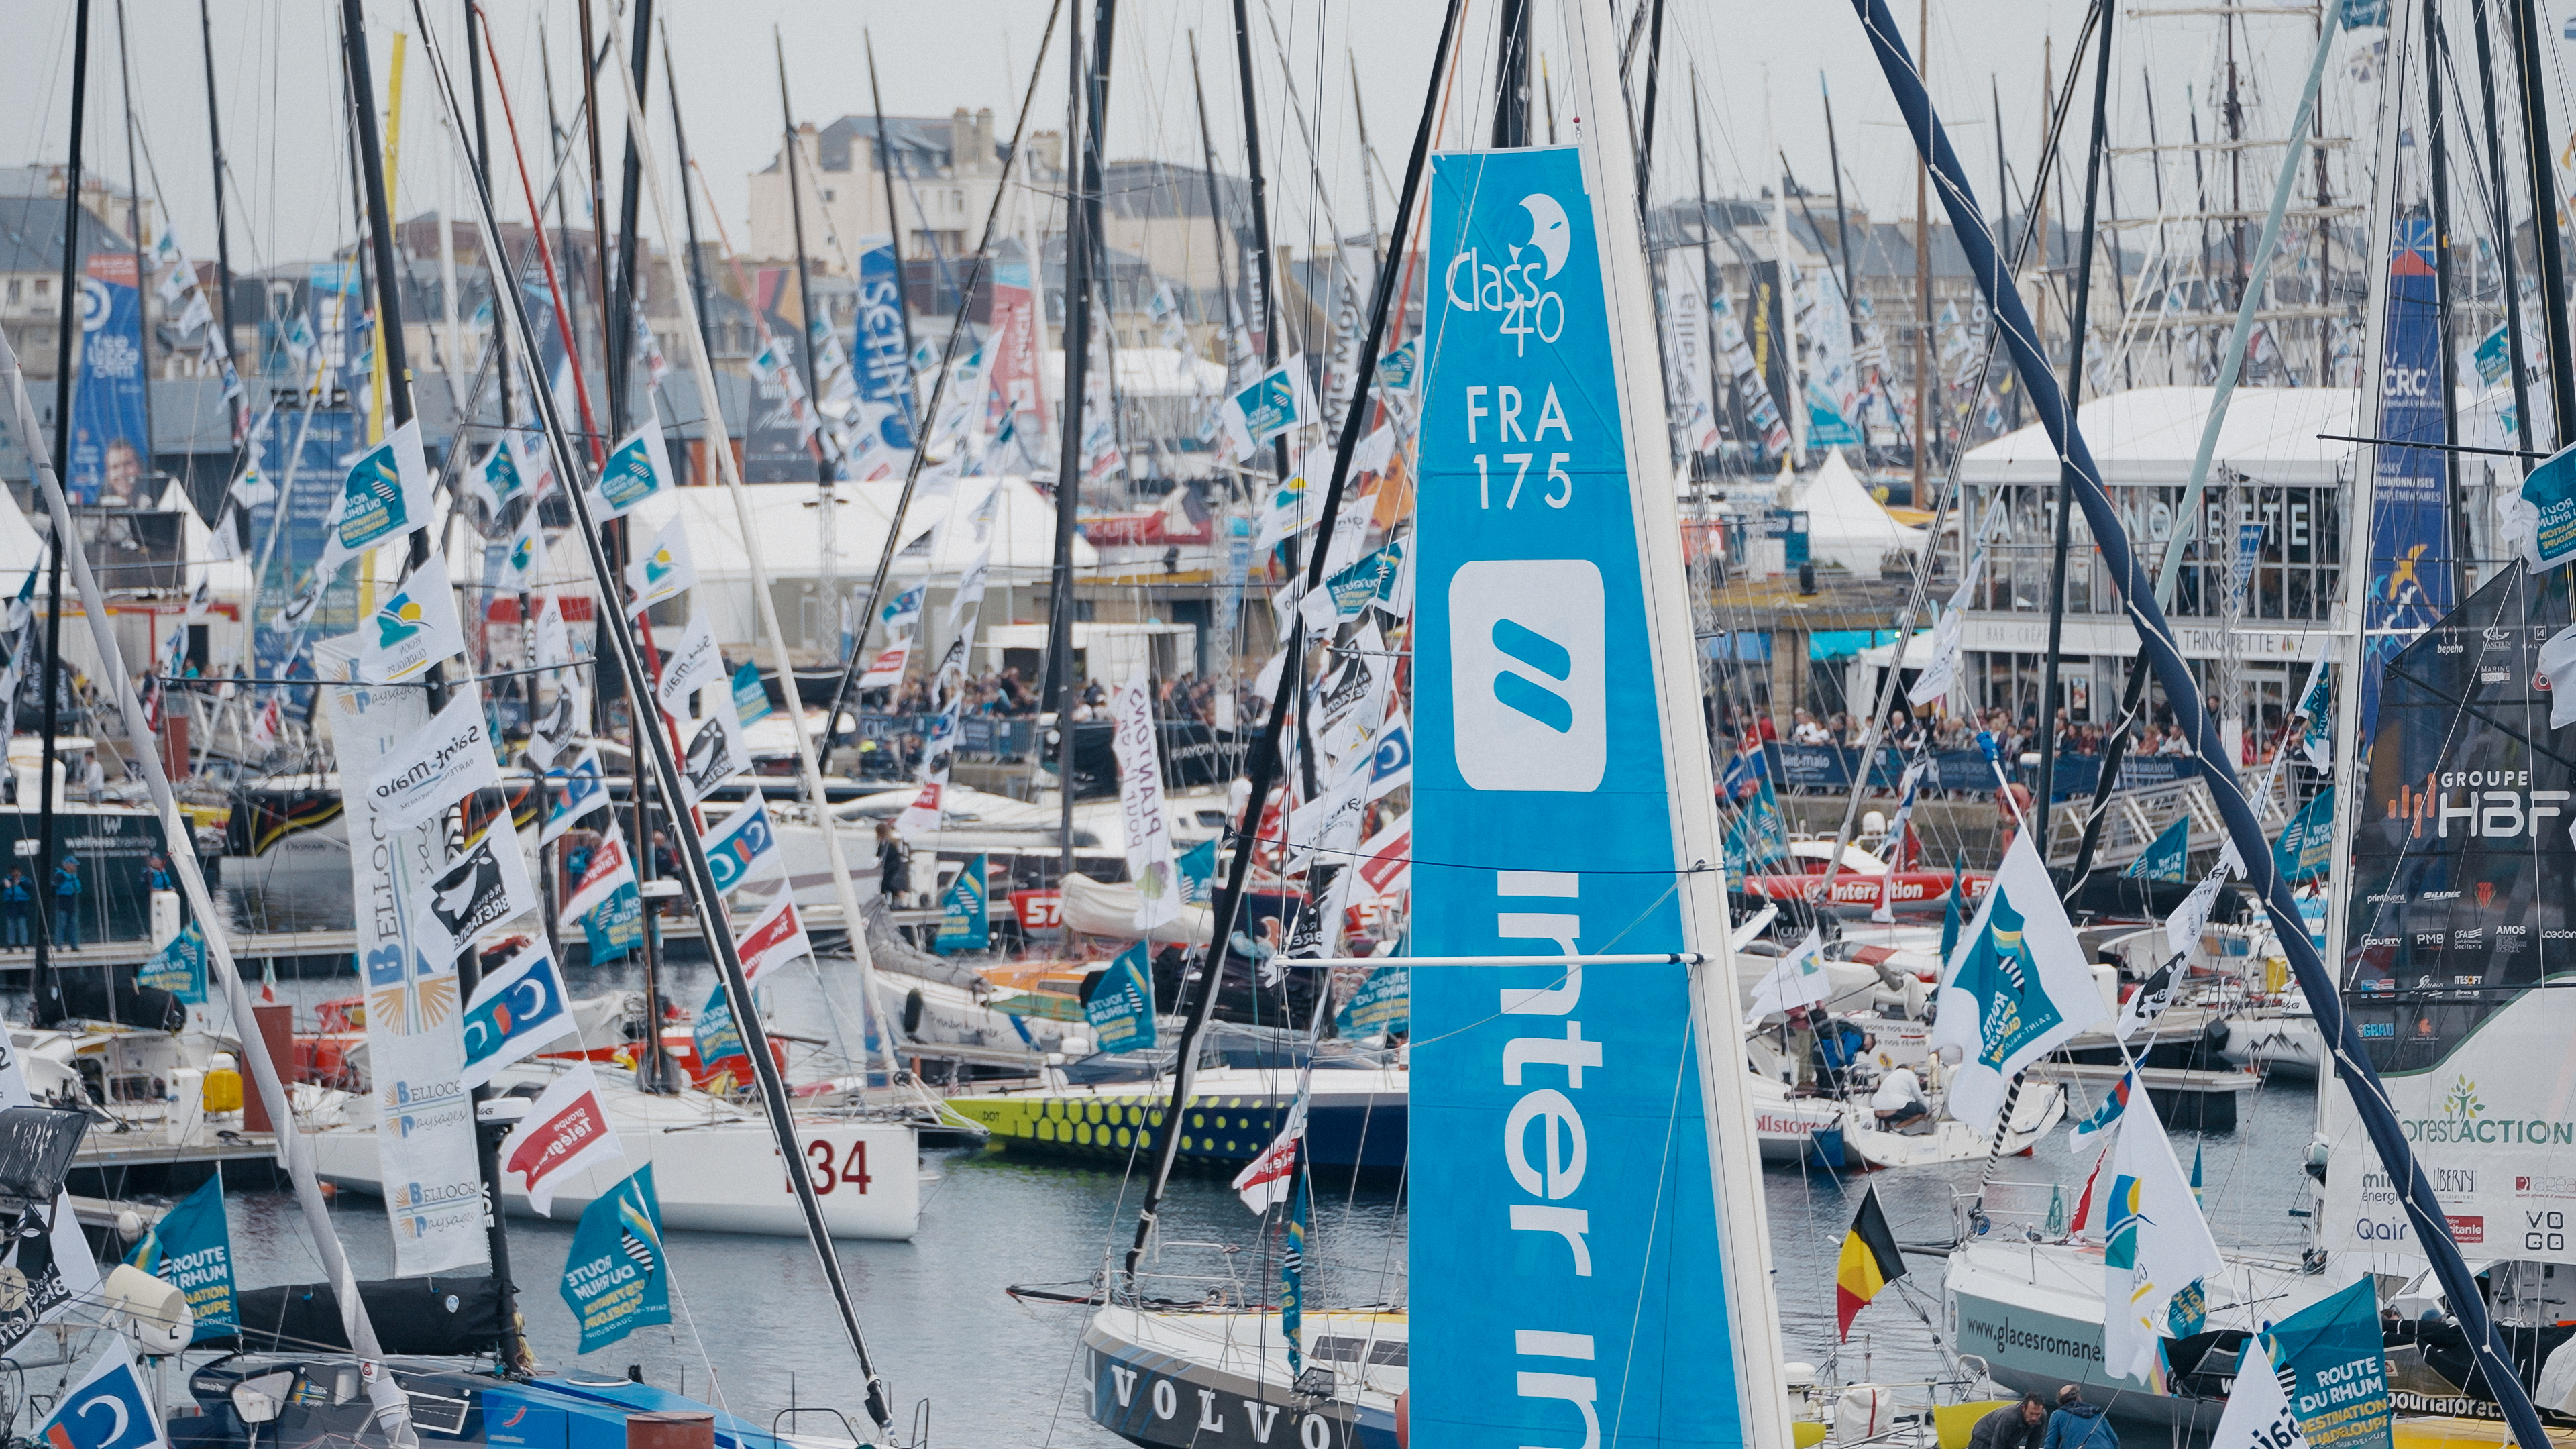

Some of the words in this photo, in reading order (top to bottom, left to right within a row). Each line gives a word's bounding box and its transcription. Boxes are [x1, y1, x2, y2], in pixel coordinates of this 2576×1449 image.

[1445, 247, 1542, 311] Class
[1499, 292, 1564, 358] 40
[2384, 368, 2427, 396] CRC
[1467, 382, 1573, 443] FRA
[1472, 453, 1572, 511] 175
[1969, 501, 2011, 541] LA
[2438, 644, 2463, 655] bepeho
[2441, 771, 2529, 788] GROUPE
[2438, 790, 2571, 838] HBF
[1026, 897, 1061, 924] 57
[2417, 934, 2444, 944] PMB
[2455, 930, 2469, 939] CFA
[2496, 925, 2526, 934] AMOS
[2363, 1023, 2394, 1037] GRAU
[409, 1181, 476, 1205] BELLOCQ
[2357, 1216, 2407, 1240] Qair
[2526, 1210, 2563, 1229] VO
[2526, 1232, 2564, 1251] GO
[172, 1246, 227, 1275] ROUTE
[179, 1263, 229, 1289] RHUM
[2318, 1356, 2379, 1388] ROUTE
[1111, 1364, 1331, 1449] VOLVO
[2300, 1393, 2330, 1414] DU
[2330, 1375, 2384, 1406] RHUM
